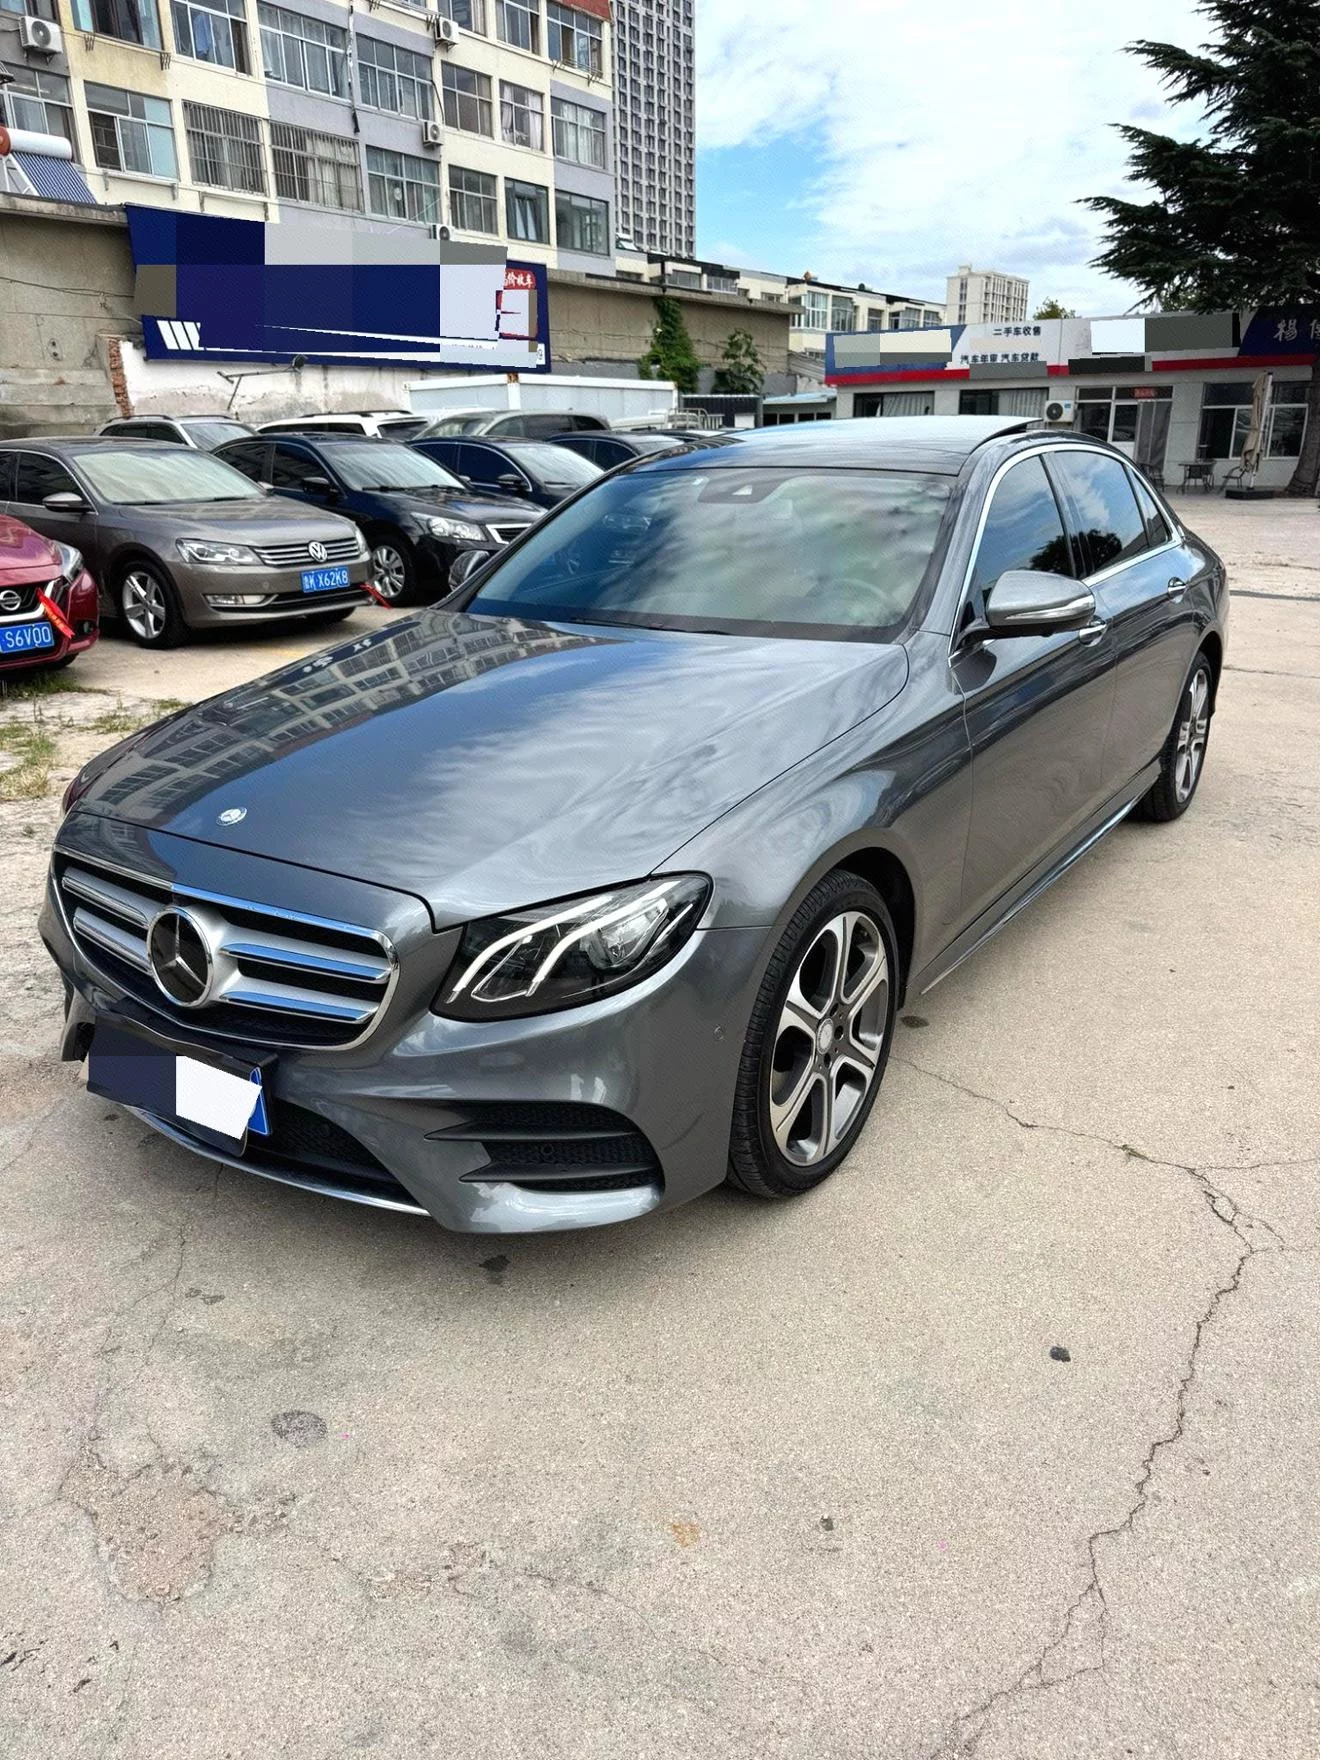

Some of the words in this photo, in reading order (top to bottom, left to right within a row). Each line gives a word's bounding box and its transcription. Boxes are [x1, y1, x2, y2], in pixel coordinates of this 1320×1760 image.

[992, 326, 1041, 337] 二手车收售
